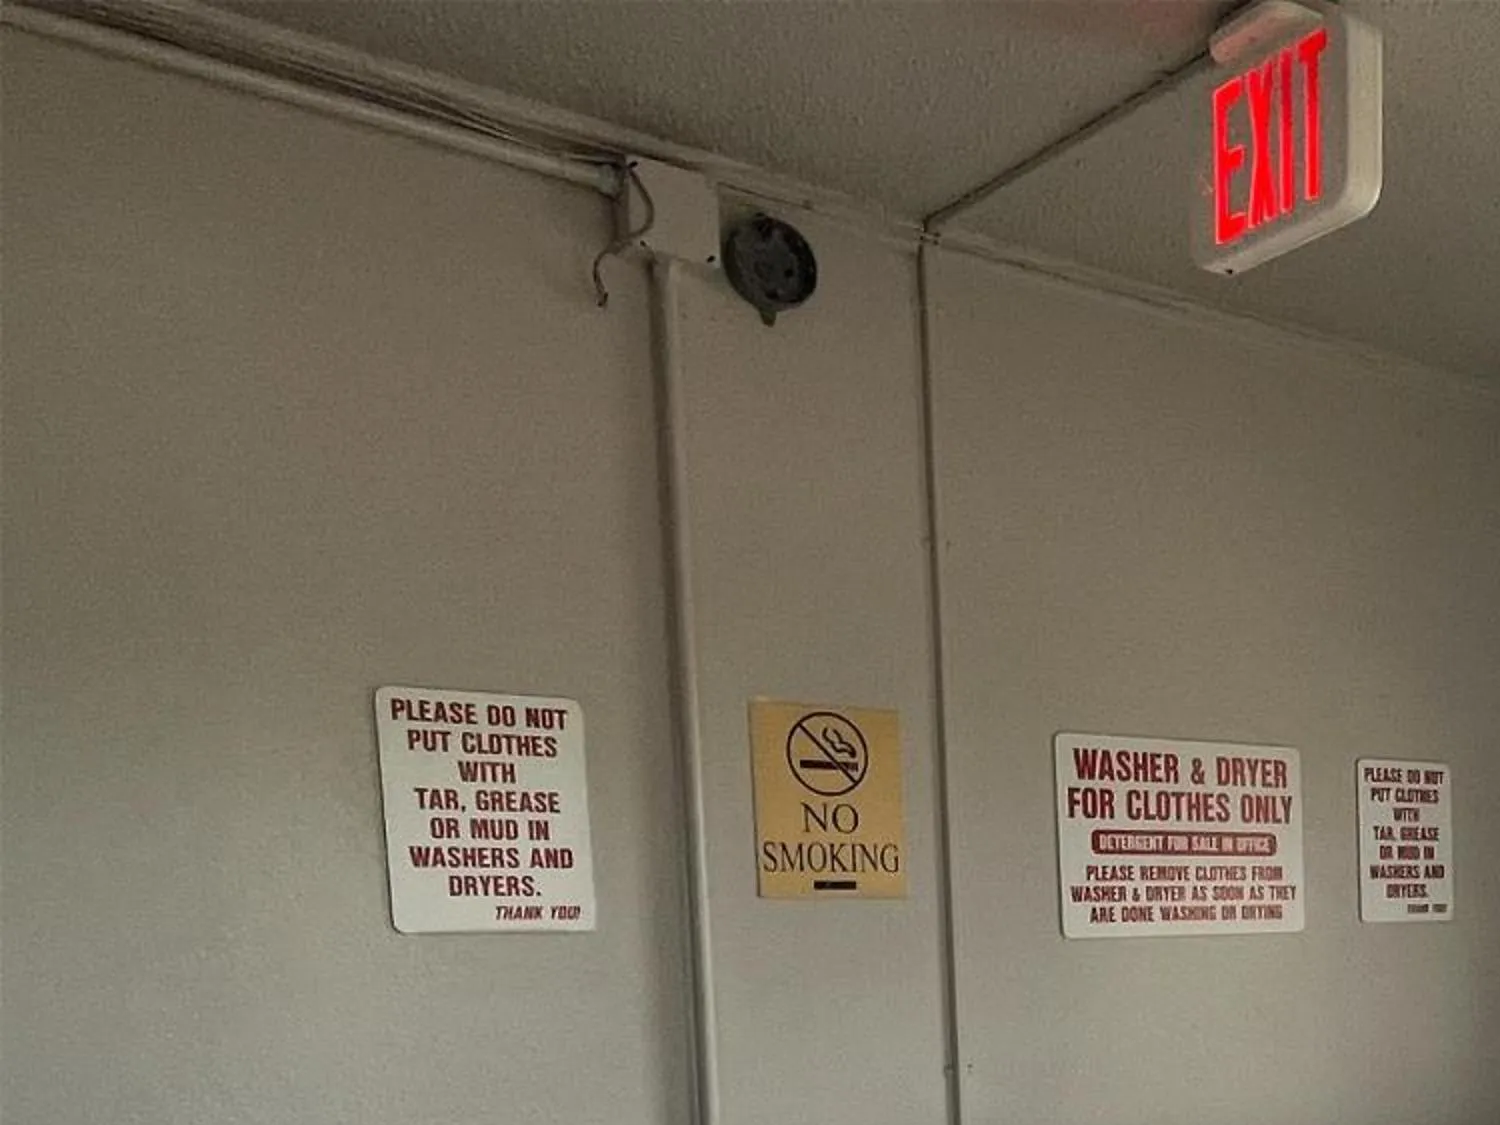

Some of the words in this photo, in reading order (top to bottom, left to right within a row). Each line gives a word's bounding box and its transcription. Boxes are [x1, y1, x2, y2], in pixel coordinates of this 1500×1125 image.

[1212, 27, 1327, 245] EXIT
[391, 698, 478, 725] PLEASE
[487, 704, 516, 727] DO
[526, 707, 568, 730] NOT
[407, 729, 450, 753] PUT
[461, 731, 558, 757] CLOTHES
[458, 760, 516, 784] WITH
[1072, 748, 1180, 785] WASHER
[1191, 757, 1205, 786] &
[1216, 755, 1287, 789] DRYER
[1364, 767, 1402, 783] PLEASE
[1407, 769, 1421, 784] DO
[1424, 770, 1445, 785] NOT
[414, 787, 467, 814] TAR,
[475, 789, 561, 814] GREASE
[1067, 787, 1115, 820] FOR
[1126, 789, 1231, 824] CLOTHES
[1240, 795, 1293, 824] ONLY
[1370, 787, 1392, 802] PUT
[1395, 788, 1439, 803] CLOTHES
[430, 817, 460, 839] OR
[470, 818, 519, 840] MUD
[528, 820, 550, 841] IN
[801, 801, 859, 834] NO
[1099, 834, 1163, 850] DETERGENT
[1400, 826, 1440, 841] GREASE
[409, 845, 520, 868] WASHERS
[530, 848, 574, 869] AND
[763, 841, 899, 873] SMOKING
[1379, 845, 1394, 860] OR
[1086, 865, 1135, 882] PLEASE
[1140, 865, 1191, 881] REMOVE
[1195, 865, 1247, 881] CLOTHES
[1251, 865, 1284, 880] FROM
[1370, 864, 1420, 879] WASHERS
[1424, 864, 1445, 879] AND
[449, 875, 542, 897] DRYERS.
[1070, 885, 1127, 903] WASHER
[1132, 886, 1140, 902] &
[1146, 886, 1186, 902] DRYER
[1192, 885, 1208, 901] AS
[1212, 886, 1245, 901] SOON
[1249, 885, 1265, 900] AS
[1269, 885, 1297, 901] THEY
[495, 905, 543, 920] THANK
[1090, 906, 1115, 924] ARE
[1121, 906, 1155, 923] DONE
[1160, 905, 1217, 921] WASHING
[1221, 905, 1237, 920] OR
[1241, 904, 1283, 920] DRYING
